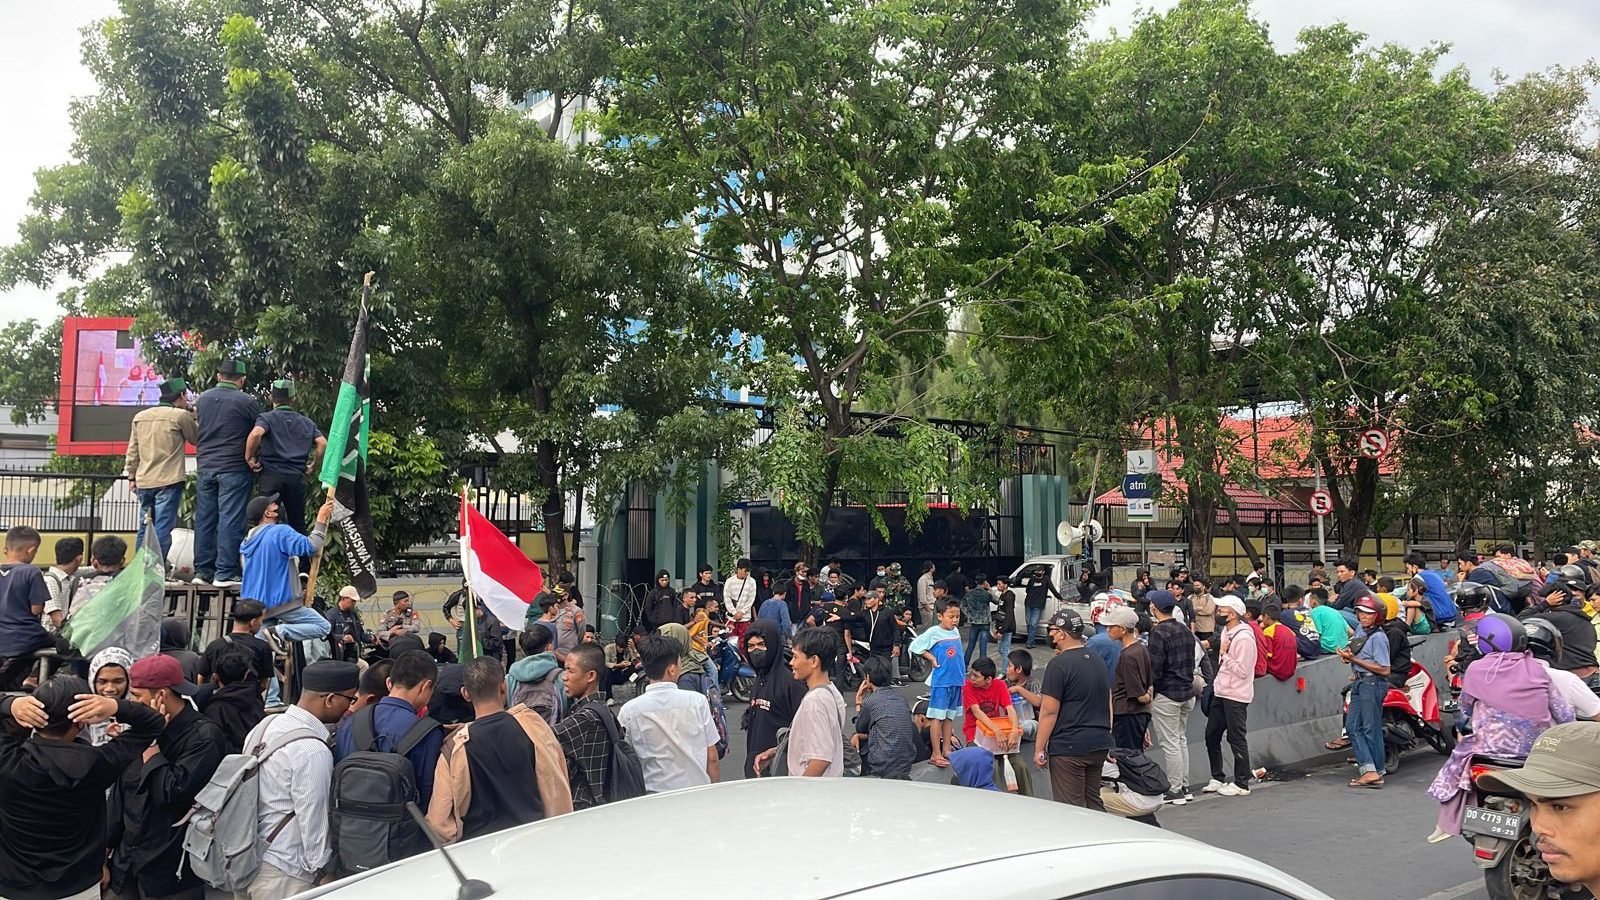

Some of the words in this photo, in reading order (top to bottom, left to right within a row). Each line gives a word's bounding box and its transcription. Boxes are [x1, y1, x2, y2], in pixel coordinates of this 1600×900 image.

[1129, 480, 1147, 490] atm
[1466, 809, 1478, 819] DD
[1480, 812, 1502, 824] 4779
[1505, 816, 1518, 828] KH
